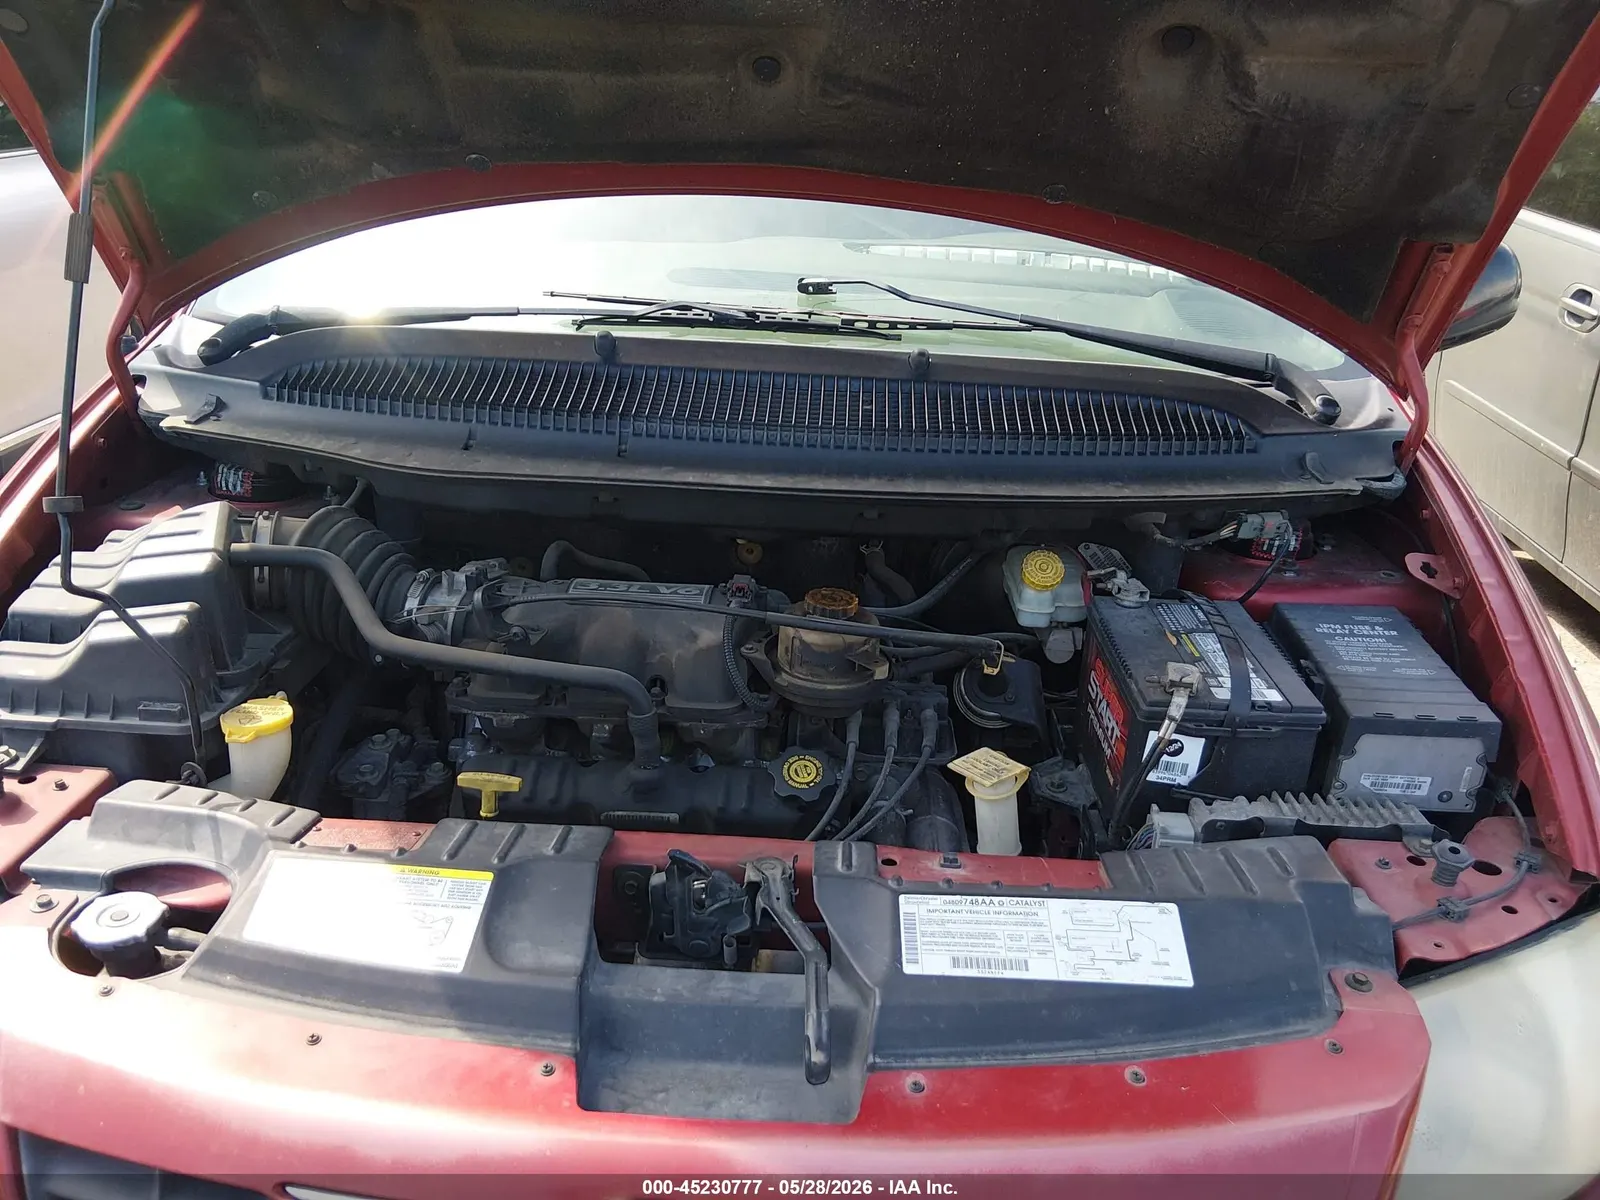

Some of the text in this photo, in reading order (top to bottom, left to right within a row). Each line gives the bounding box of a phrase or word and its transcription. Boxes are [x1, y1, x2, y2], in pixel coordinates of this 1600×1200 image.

[576, 581, 700, 595] 3.3L V6
[1088, 669, 1121, 745] START
[1087, 702, 1111, 760] PREMIUM
[407, 868, 440, 876] WARNING
[1008, 899, 1046, 907] CATALYST
[992, 909, 1039, 917] INFORMATION
